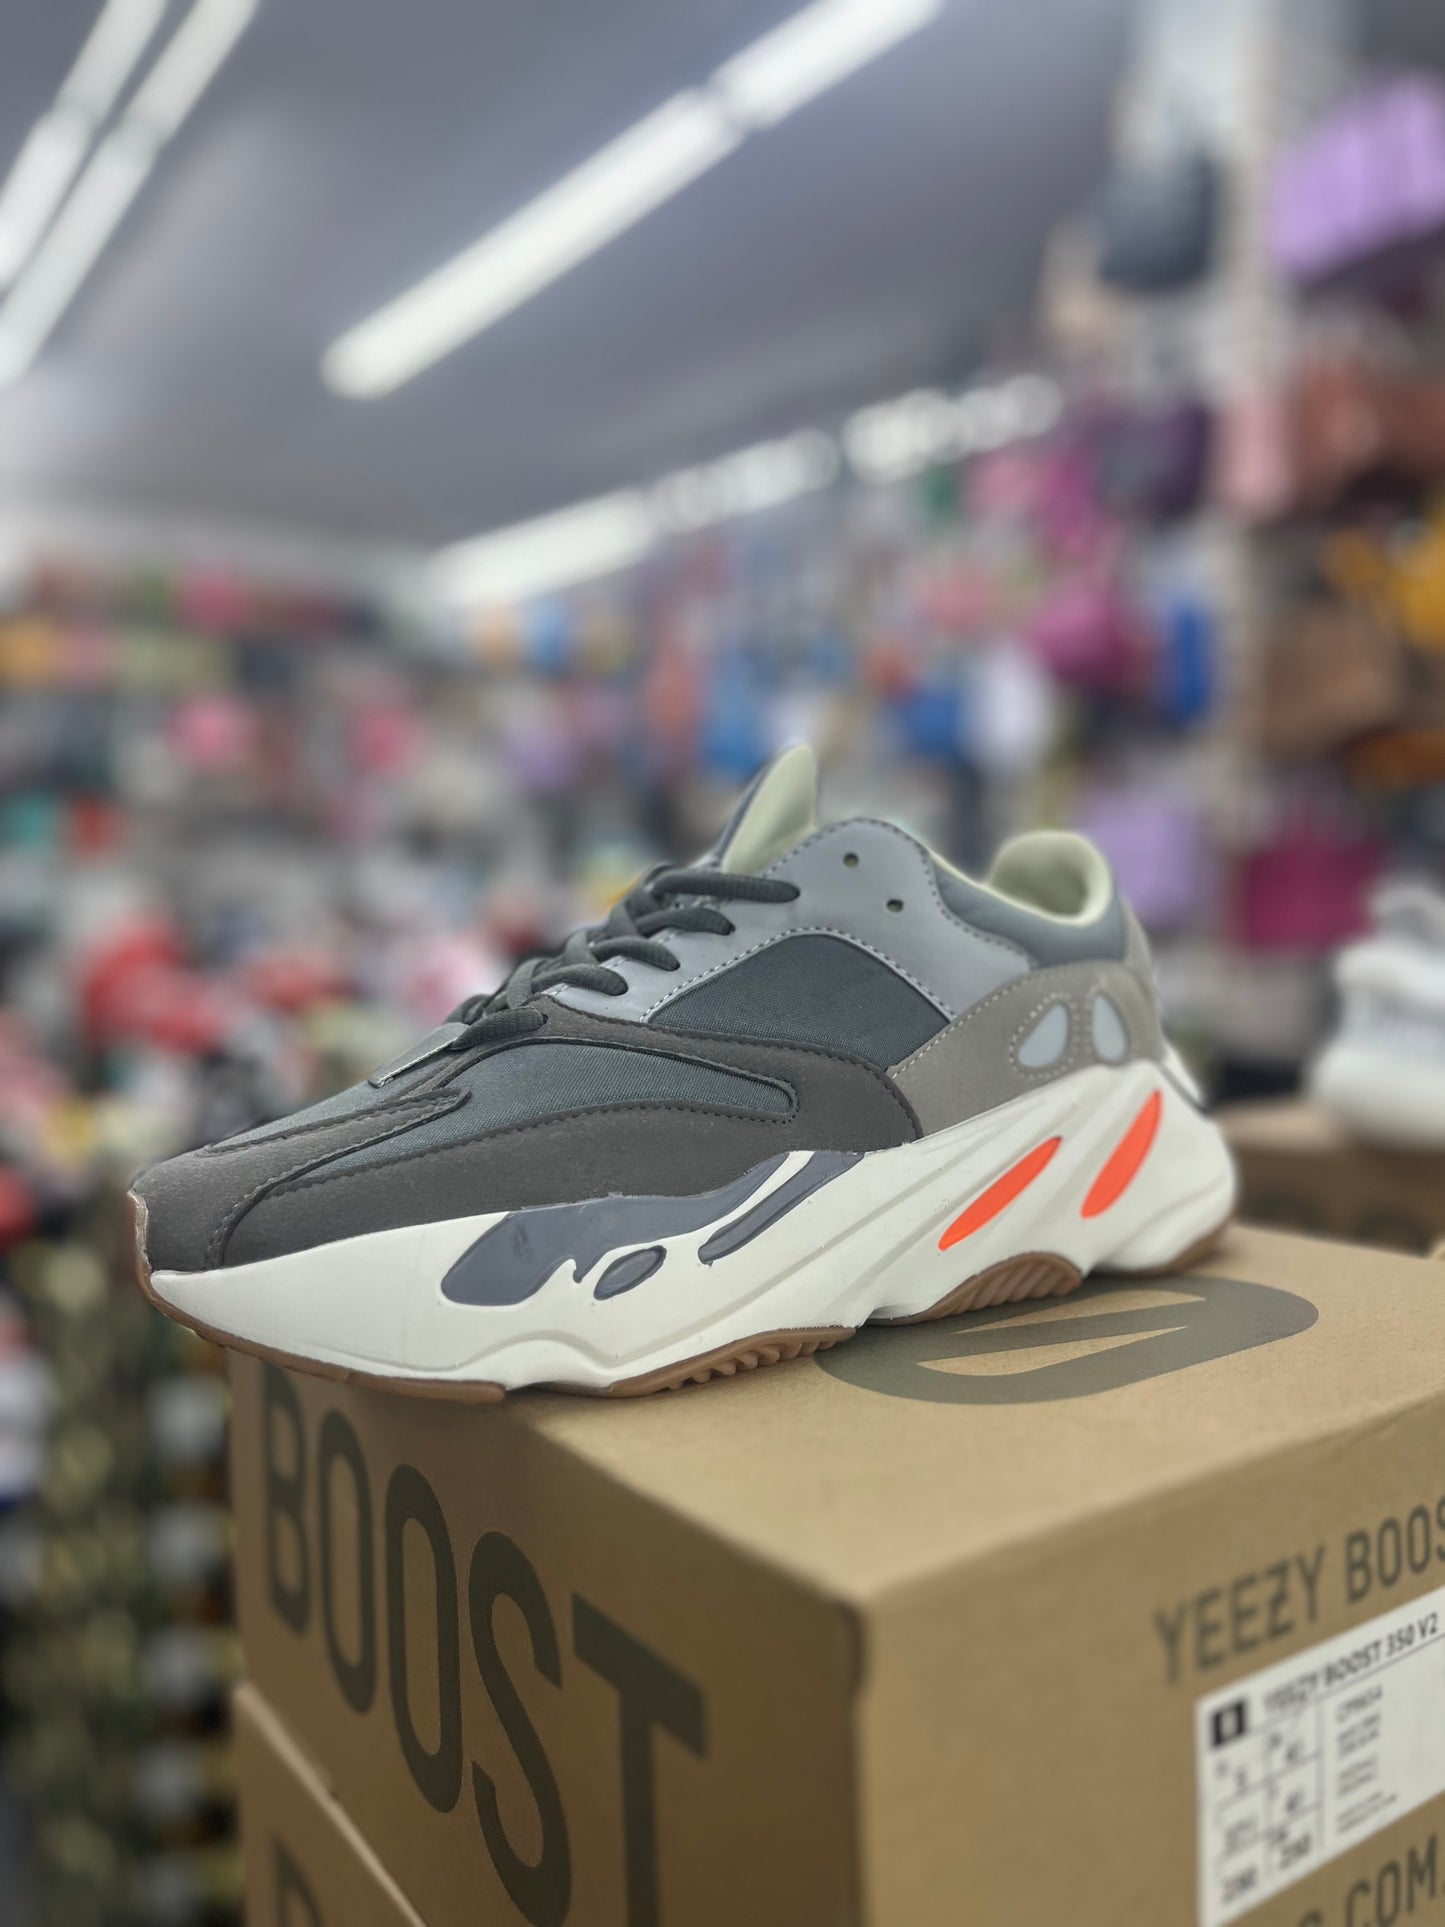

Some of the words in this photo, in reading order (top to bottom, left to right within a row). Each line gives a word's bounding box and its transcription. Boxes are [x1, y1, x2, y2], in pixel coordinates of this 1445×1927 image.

[264, 1357, 709, 1927] BOOST
[1153, 1545, 1326, 1687] YEEZY
[1324, 1640, 1381, 1687] BOOST
[1386, 1624, 1415, 1657] 350
[1417, 1612, 1438, 1638] V2
